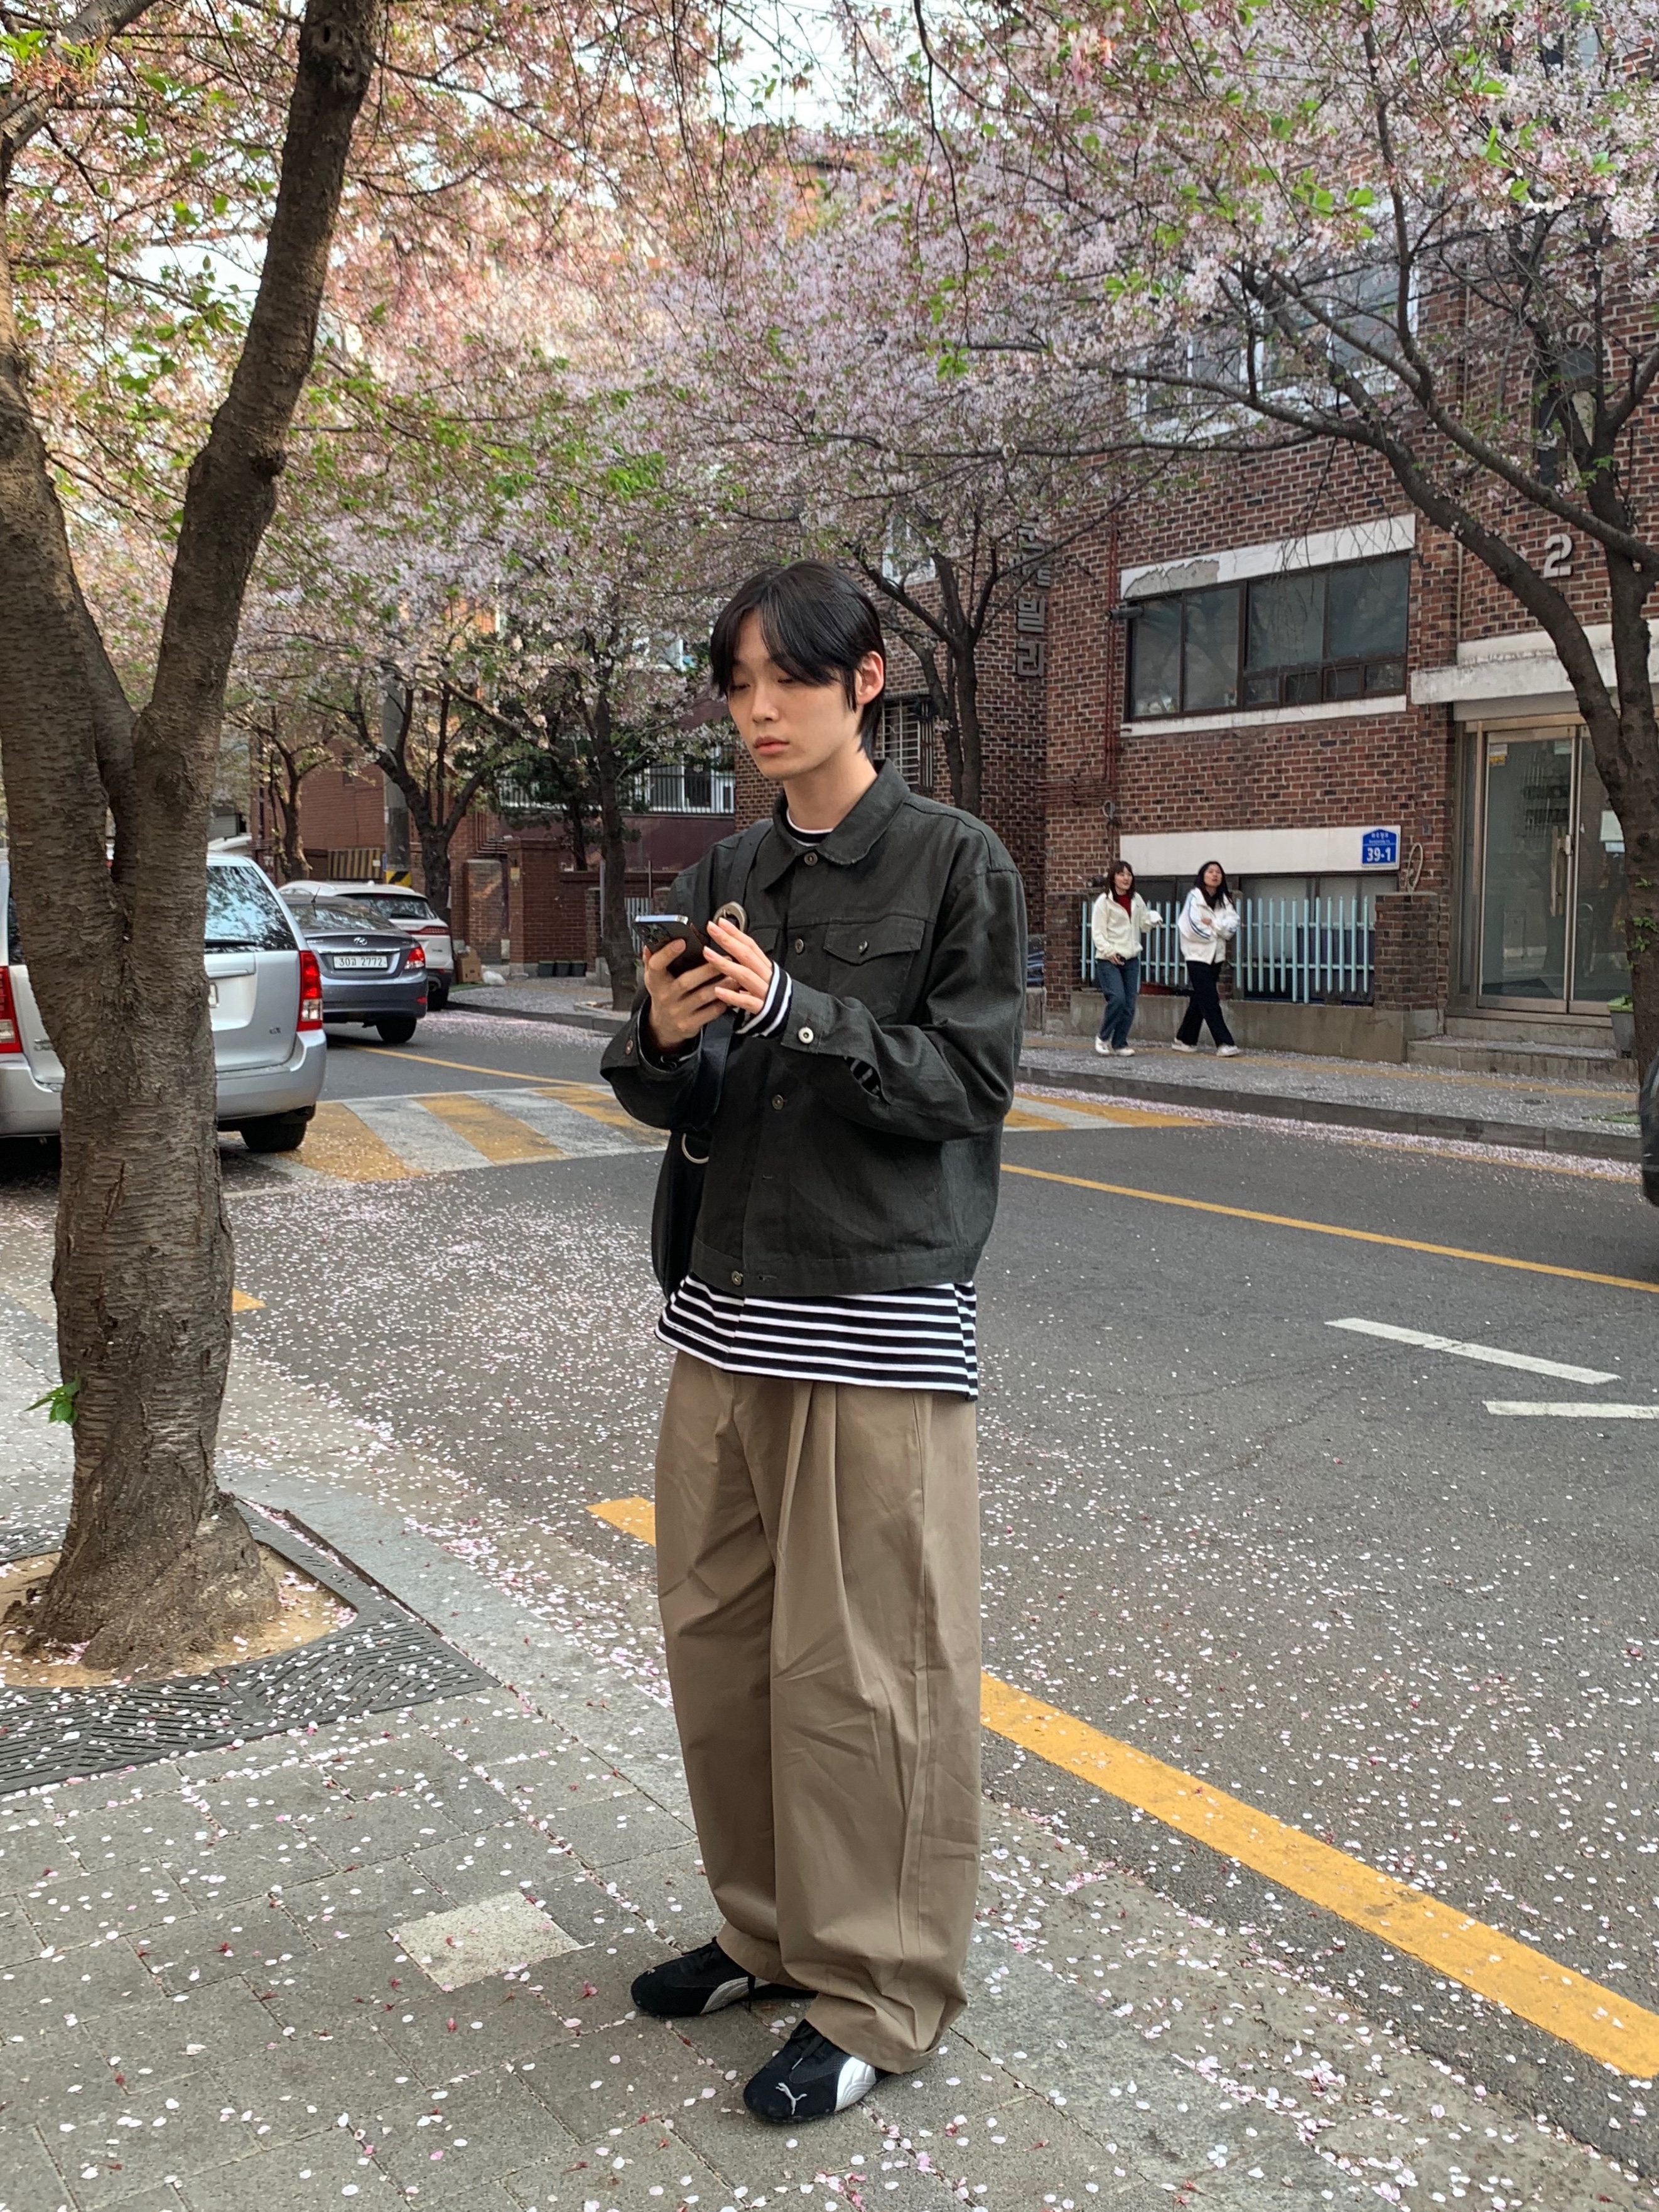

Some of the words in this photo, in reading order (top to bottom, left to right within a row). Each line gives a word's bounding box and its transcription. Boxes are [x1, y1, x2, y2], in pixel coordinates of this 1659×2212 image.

[1543, 533, 1572, 577] 2
[1366, 847, 1392, 862] 39-1
[361, 957, 383, 967] 2772
